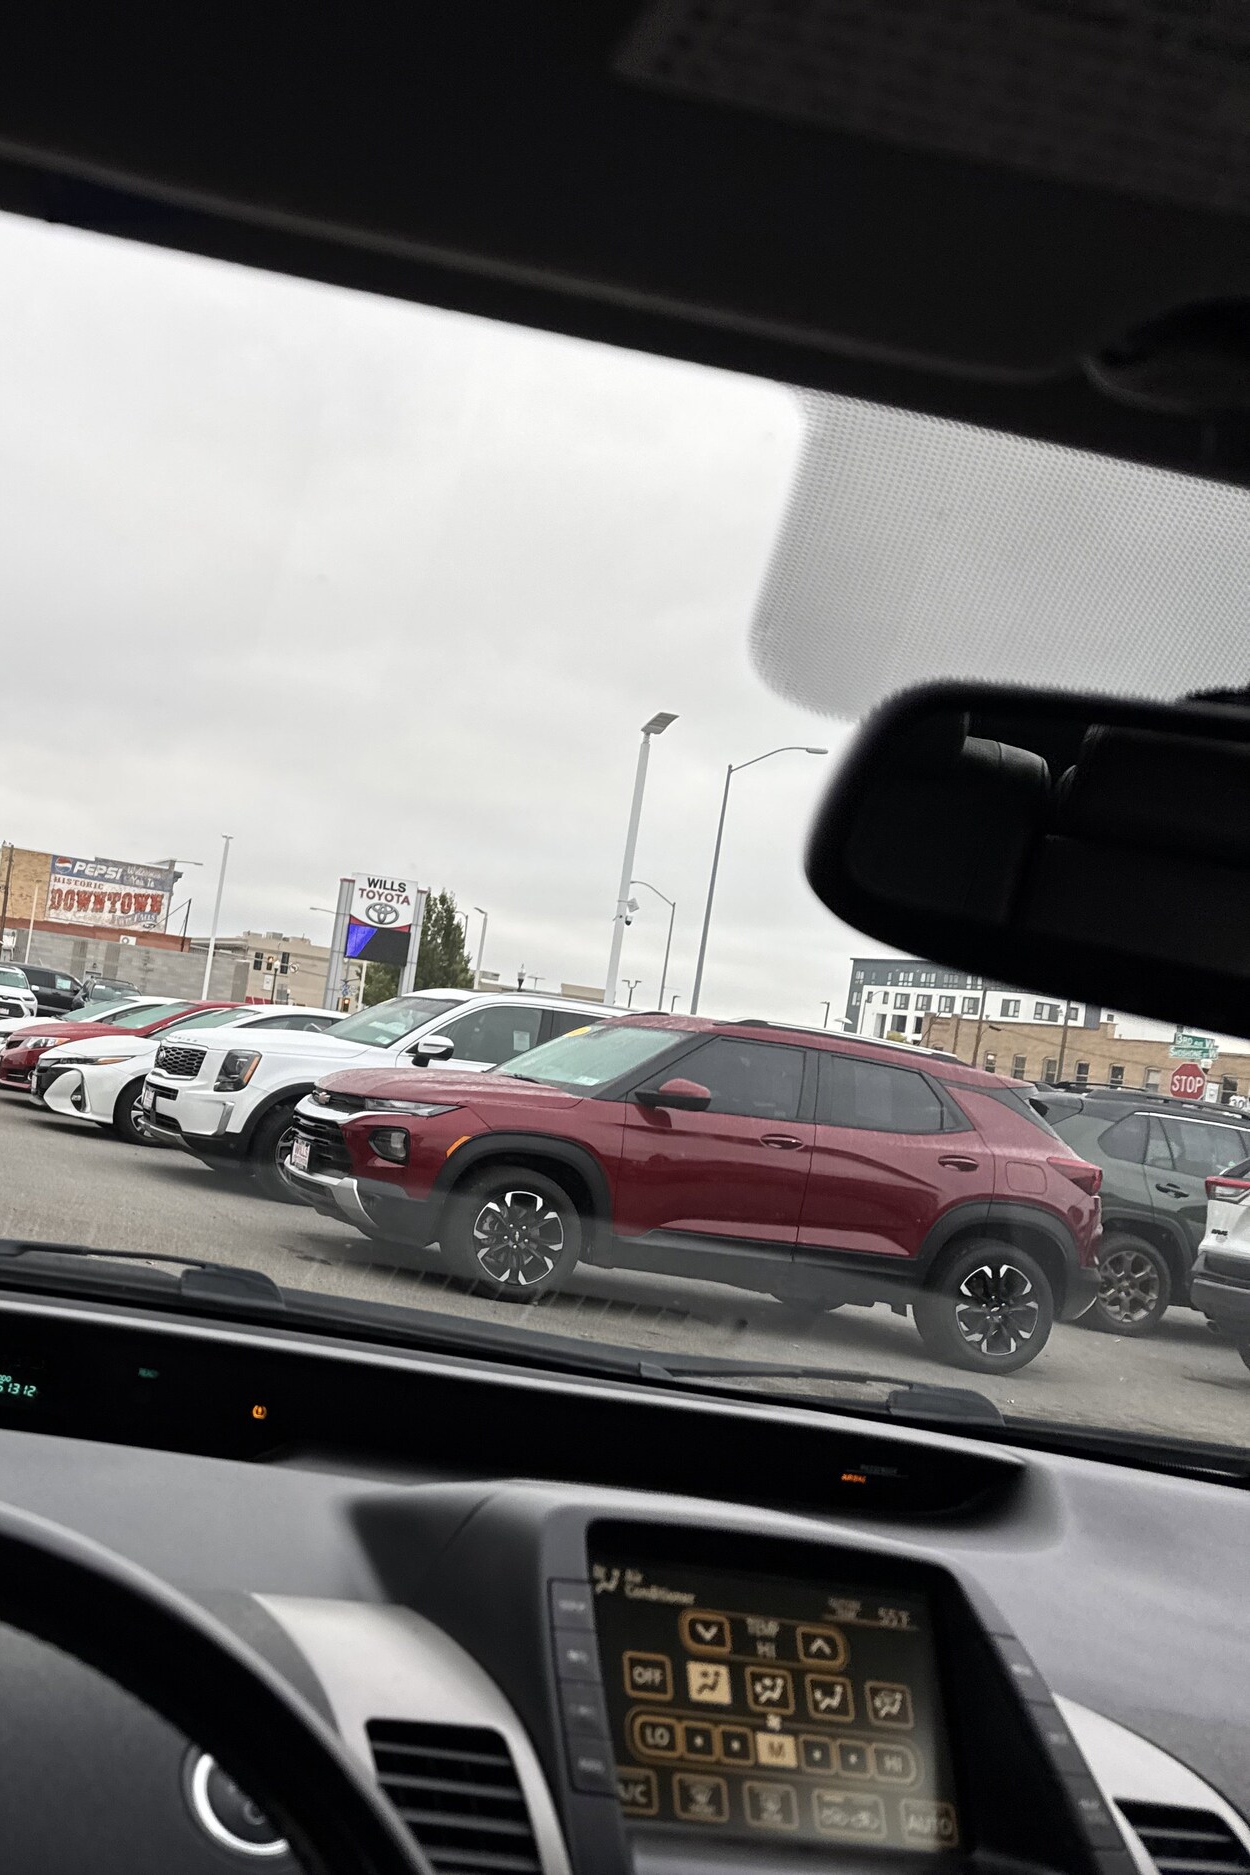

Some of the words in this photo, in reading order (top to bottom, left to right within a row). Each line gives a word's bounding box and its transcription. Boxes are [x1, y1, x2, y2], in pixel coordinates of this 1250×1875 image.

[73, 861, 123, 880] PEPSI
[54, 876, 104, 890] HISTORIC
[367, 877, 406, 893] WILLS
[50, 888, 164, 915] DOWNTOWN
[359, 888, 411, 906] TOYOTA
[1176, 1033, 1193, 1046] 3RD
[1172, 1075, 1204, 1093] STOP
[632, 1664, 663, 1686] OFF
[645, 1724, 671, 1748] LO
[767, 1741, 785, 1759] M
[907, 1811, 953, 1837] AUTO
